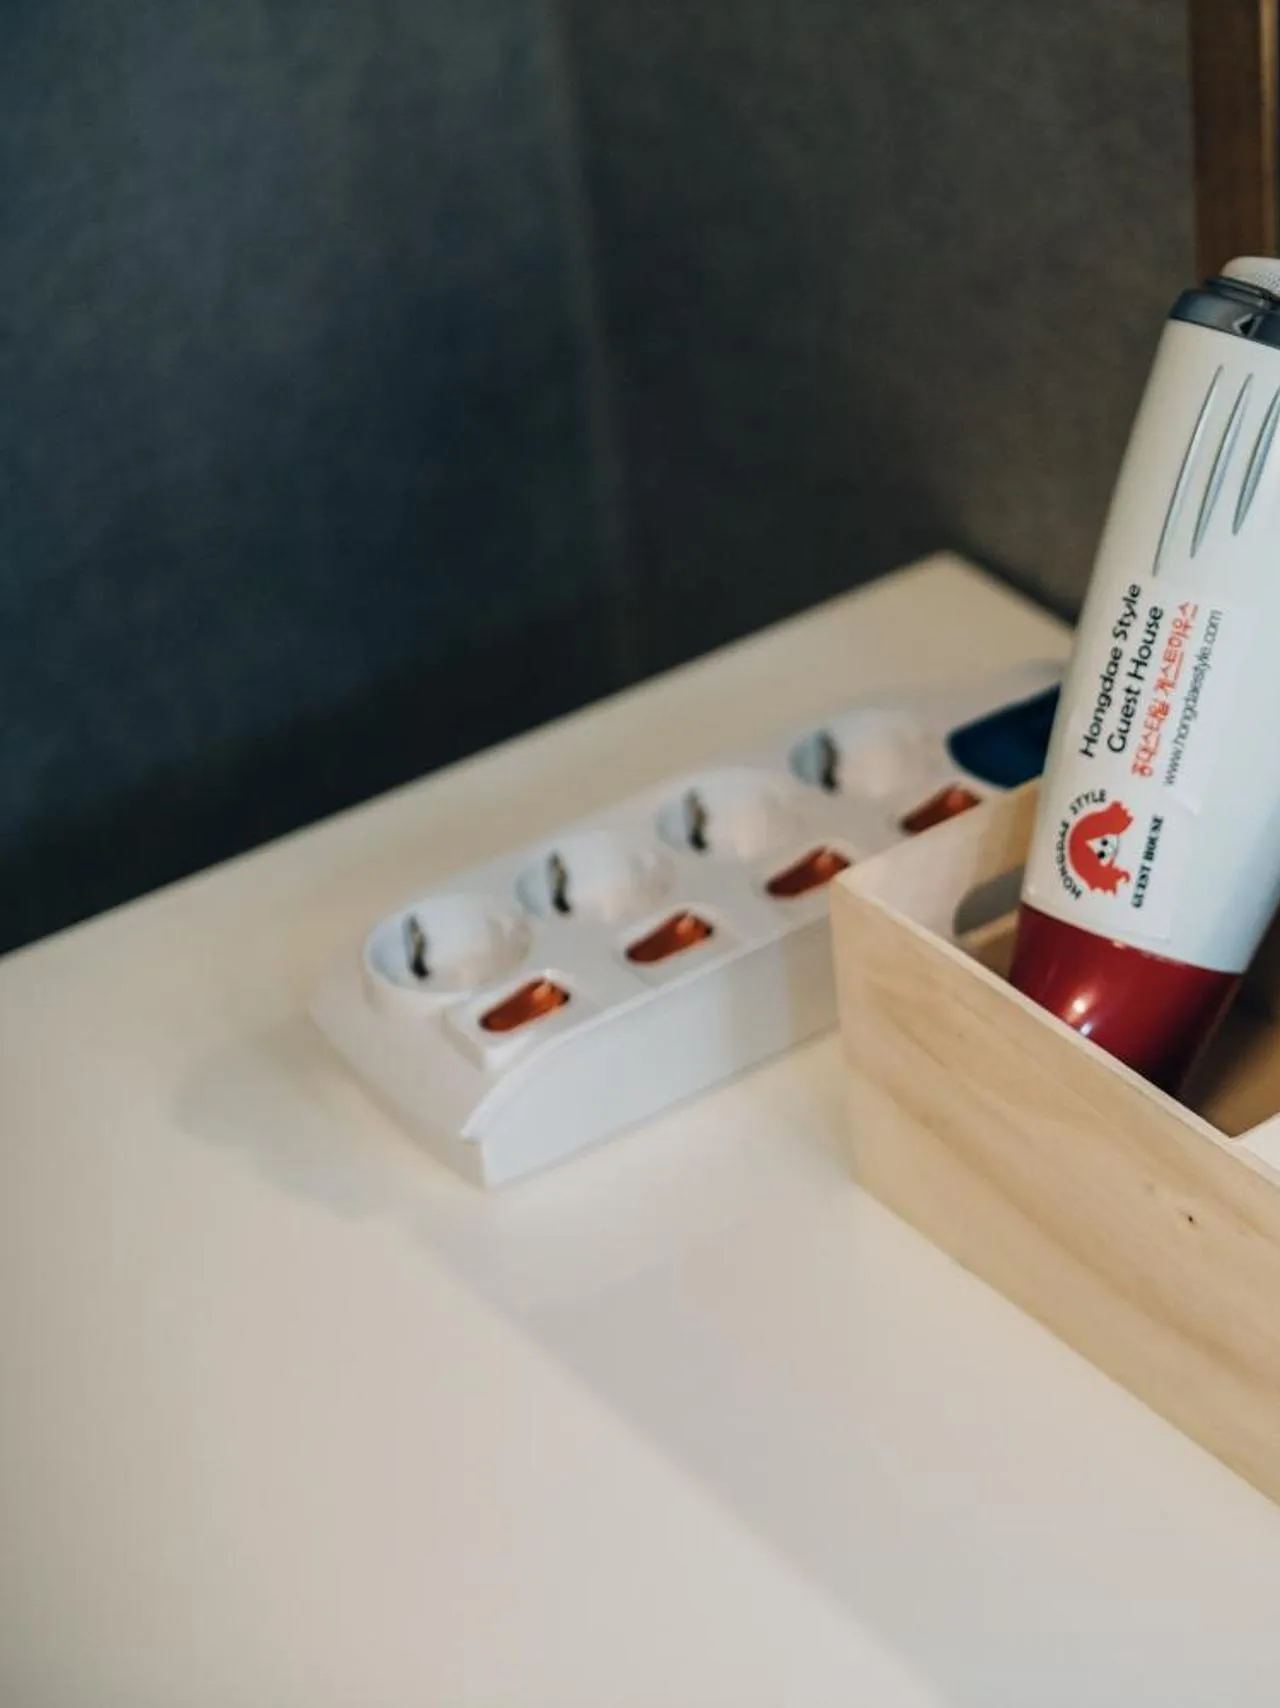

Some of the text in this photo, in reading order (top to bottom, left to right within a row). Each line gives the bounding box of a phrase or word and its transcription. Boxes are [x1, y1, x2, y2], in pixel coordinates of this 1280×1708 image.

[1079, 583, 1142, 758] Hongdae Style
[1107, 605, 1165, 754] Guest House
[1162, 610, 1223, 786] www.hongdaestyle.com
[1055, 788, 1107, 900] HONGDAE STYLE
[1131, 815, 1165, 908] GUEST HOUSE
